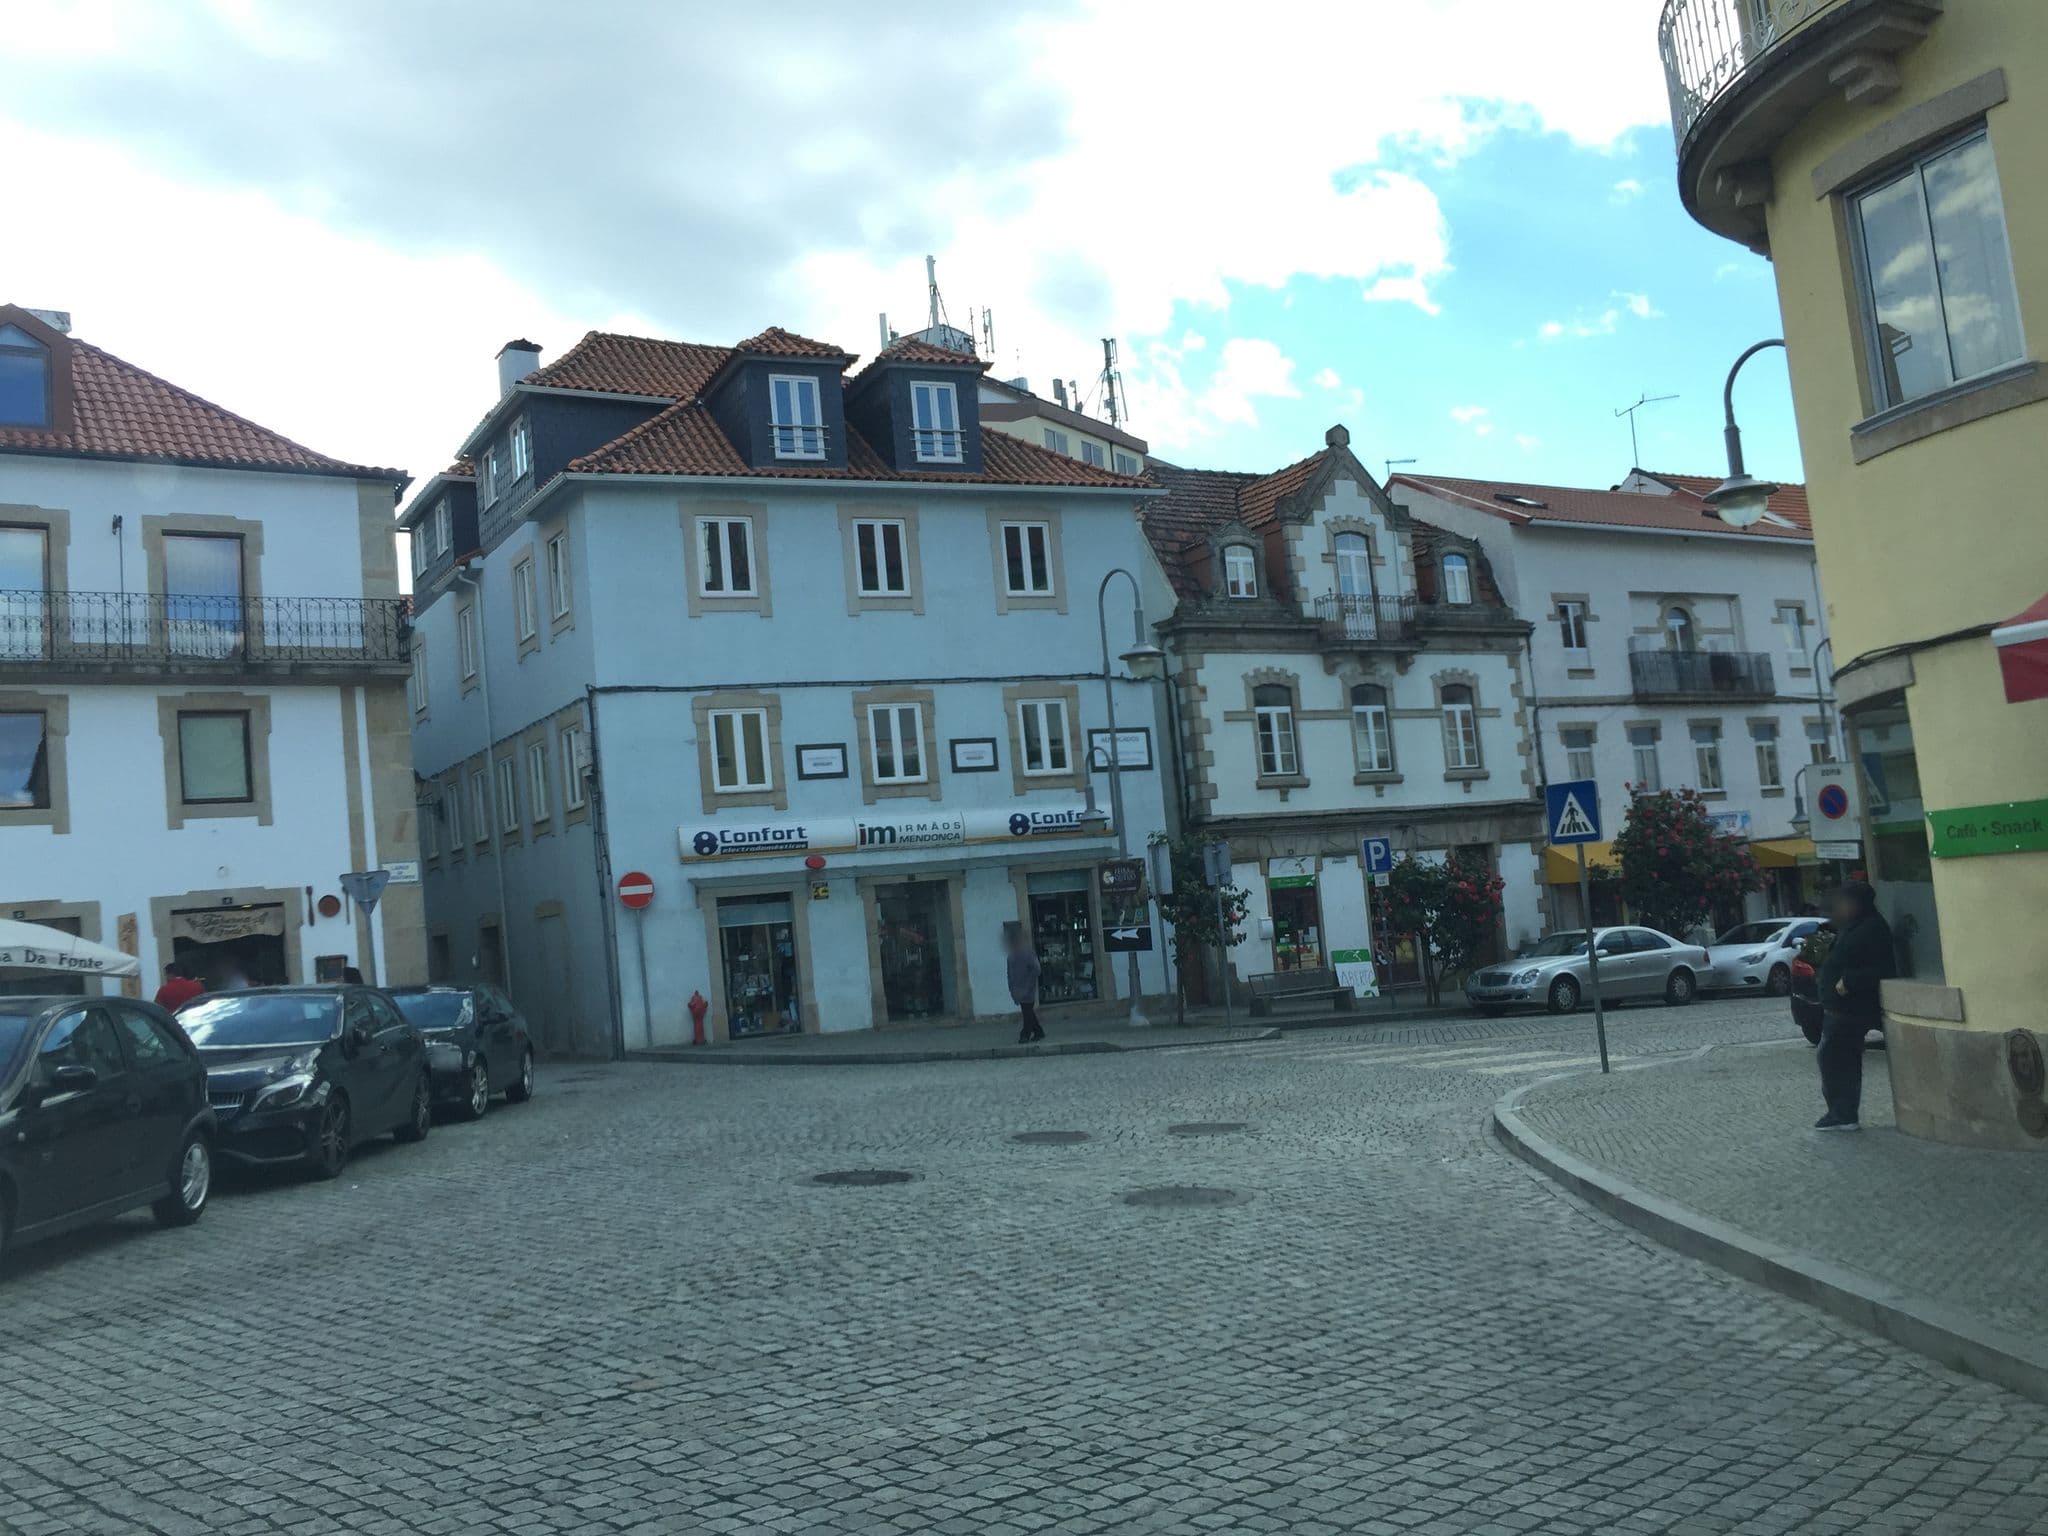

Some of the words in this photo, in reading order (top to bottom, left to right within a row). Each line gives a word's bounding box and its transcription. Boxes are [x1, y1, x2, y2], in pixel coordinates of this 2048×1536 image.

[720, 827, 808, 843] Confort
[859, 823, 896, 845] im
[899, 822, 961, 832] IRMÃOS
[1947, 824, 1977, 839] Café
[1991, 817, 2043, 836] Snack
[899, 833, 961, 843] MENDONÇA
[1369, 841, 1386, 870] P
[24, 950, 46, 964] Da
[58, 953, 104, 969] Fonte
